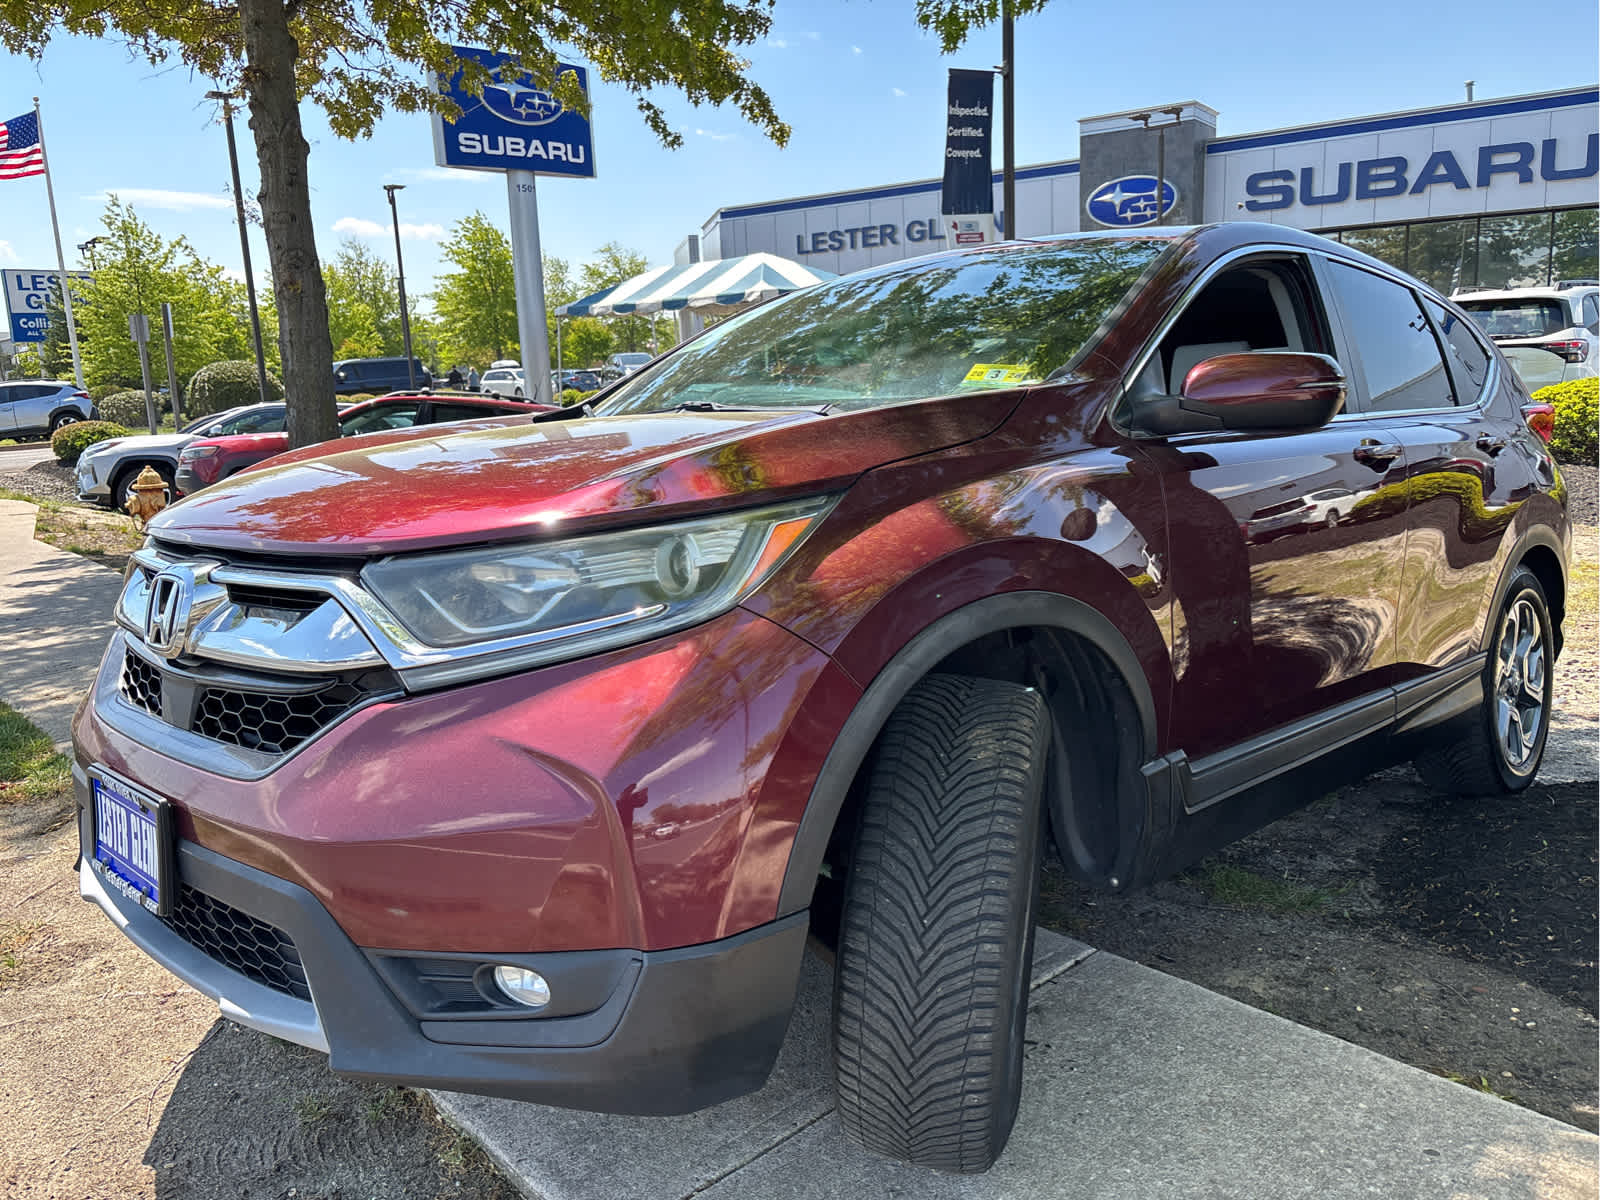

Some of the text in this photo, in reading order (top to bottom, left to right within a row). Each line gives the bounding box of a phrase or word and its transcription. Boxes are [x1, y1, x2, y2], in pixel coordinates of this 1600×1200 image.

[949, 104, 989, 117] Inspected.
[948, 127, 984, 137] Certified.
[458, 132, 585, 164] SUBARU
[947, 148, 982, 158] Covered.
[1245, 133, 1599, 212] SUBARU
[796, 223, 899, 255] LESTER
[16, 274, 65, 291] LES
[990, 370, 1001, 379] 3
[97, 791, 128, 860] LESTER
